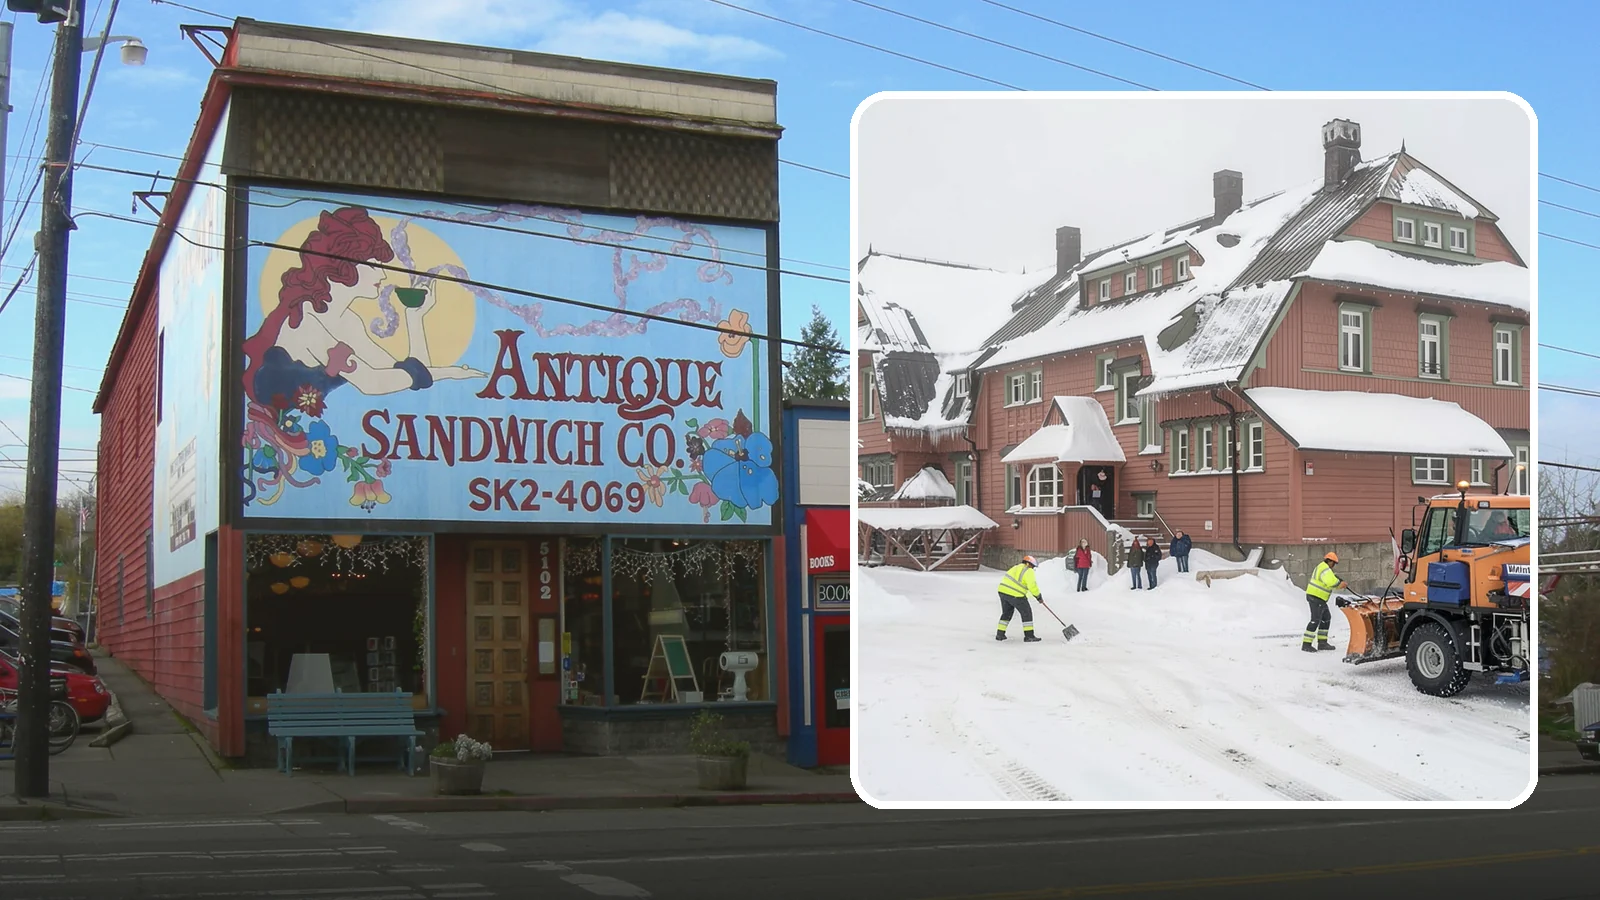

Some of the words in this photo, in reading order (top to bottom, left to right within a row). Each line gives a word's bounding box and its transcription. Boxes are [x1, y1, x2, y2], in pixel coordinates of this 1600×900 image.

[476, 328, 723, 421] ANTIQUE
[361, 408, 604, 467] SANDWICH
[617, 422, 685, 469] CO.
[468, 477, 646, 513] SK2-4069
[539, 542, 552, 600] 5102
[809, 555, 835, 569] BOOKS
